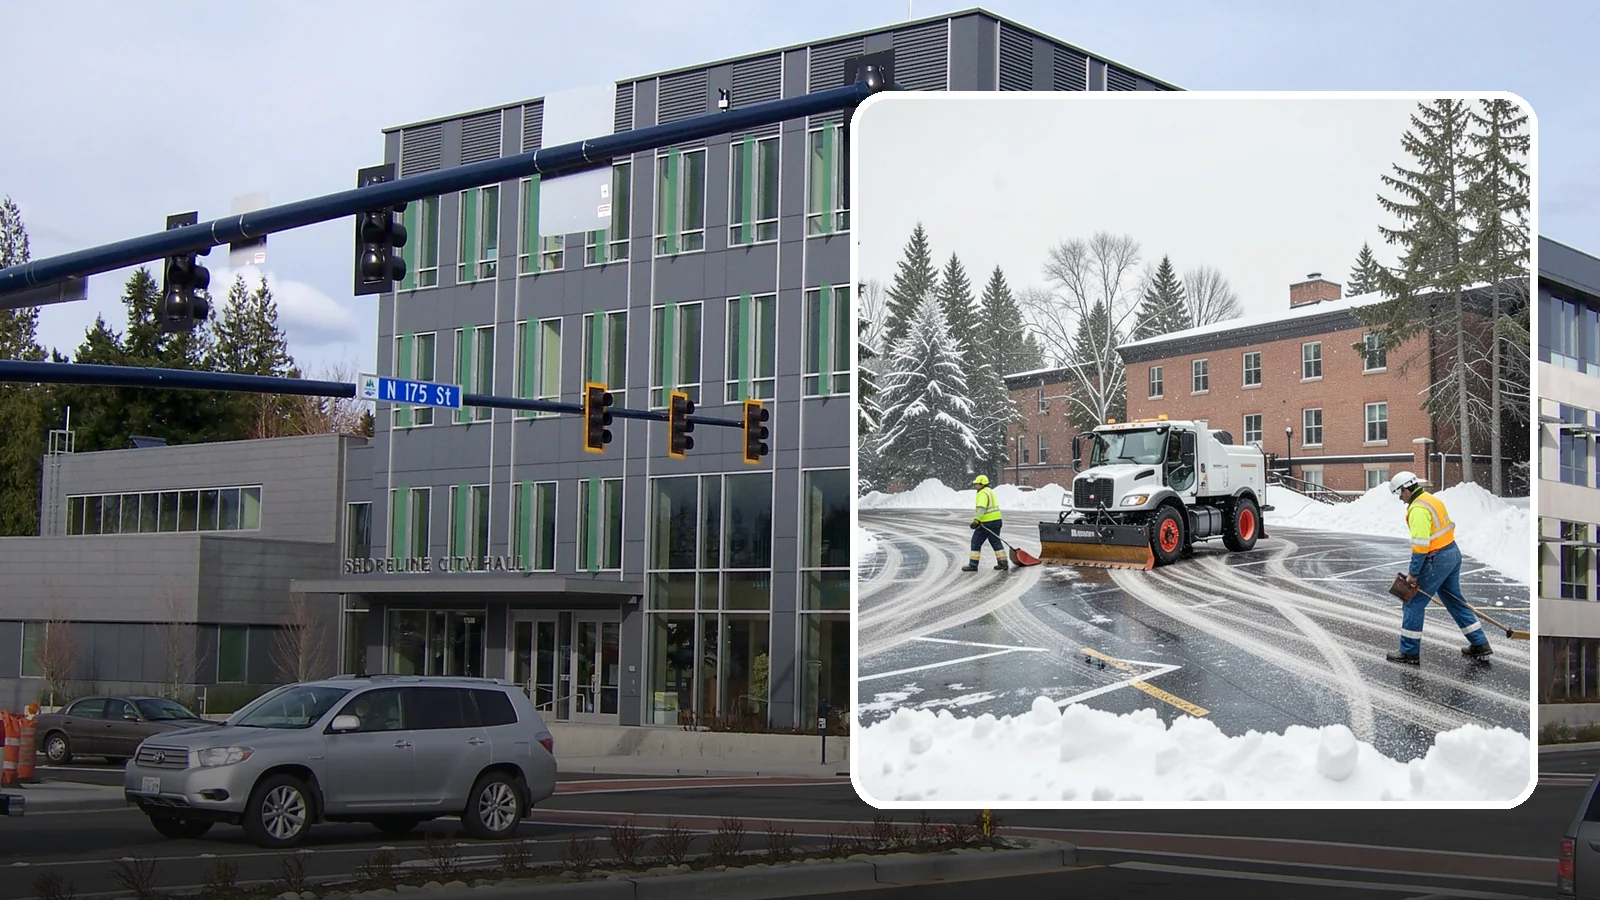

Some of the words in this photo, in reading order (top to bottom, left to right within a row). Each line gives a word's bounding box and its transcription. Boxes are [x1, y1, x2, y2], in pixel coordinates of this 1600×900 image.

[387, 381, 396, 400] N
[405, 383, 428, 403] 175
[436, 386, 452, 406] St
[344, 558, 432, 574] SHORELINE
[439, 557, 476, 572] CITY
[484, 556, 525, 572] HALL
